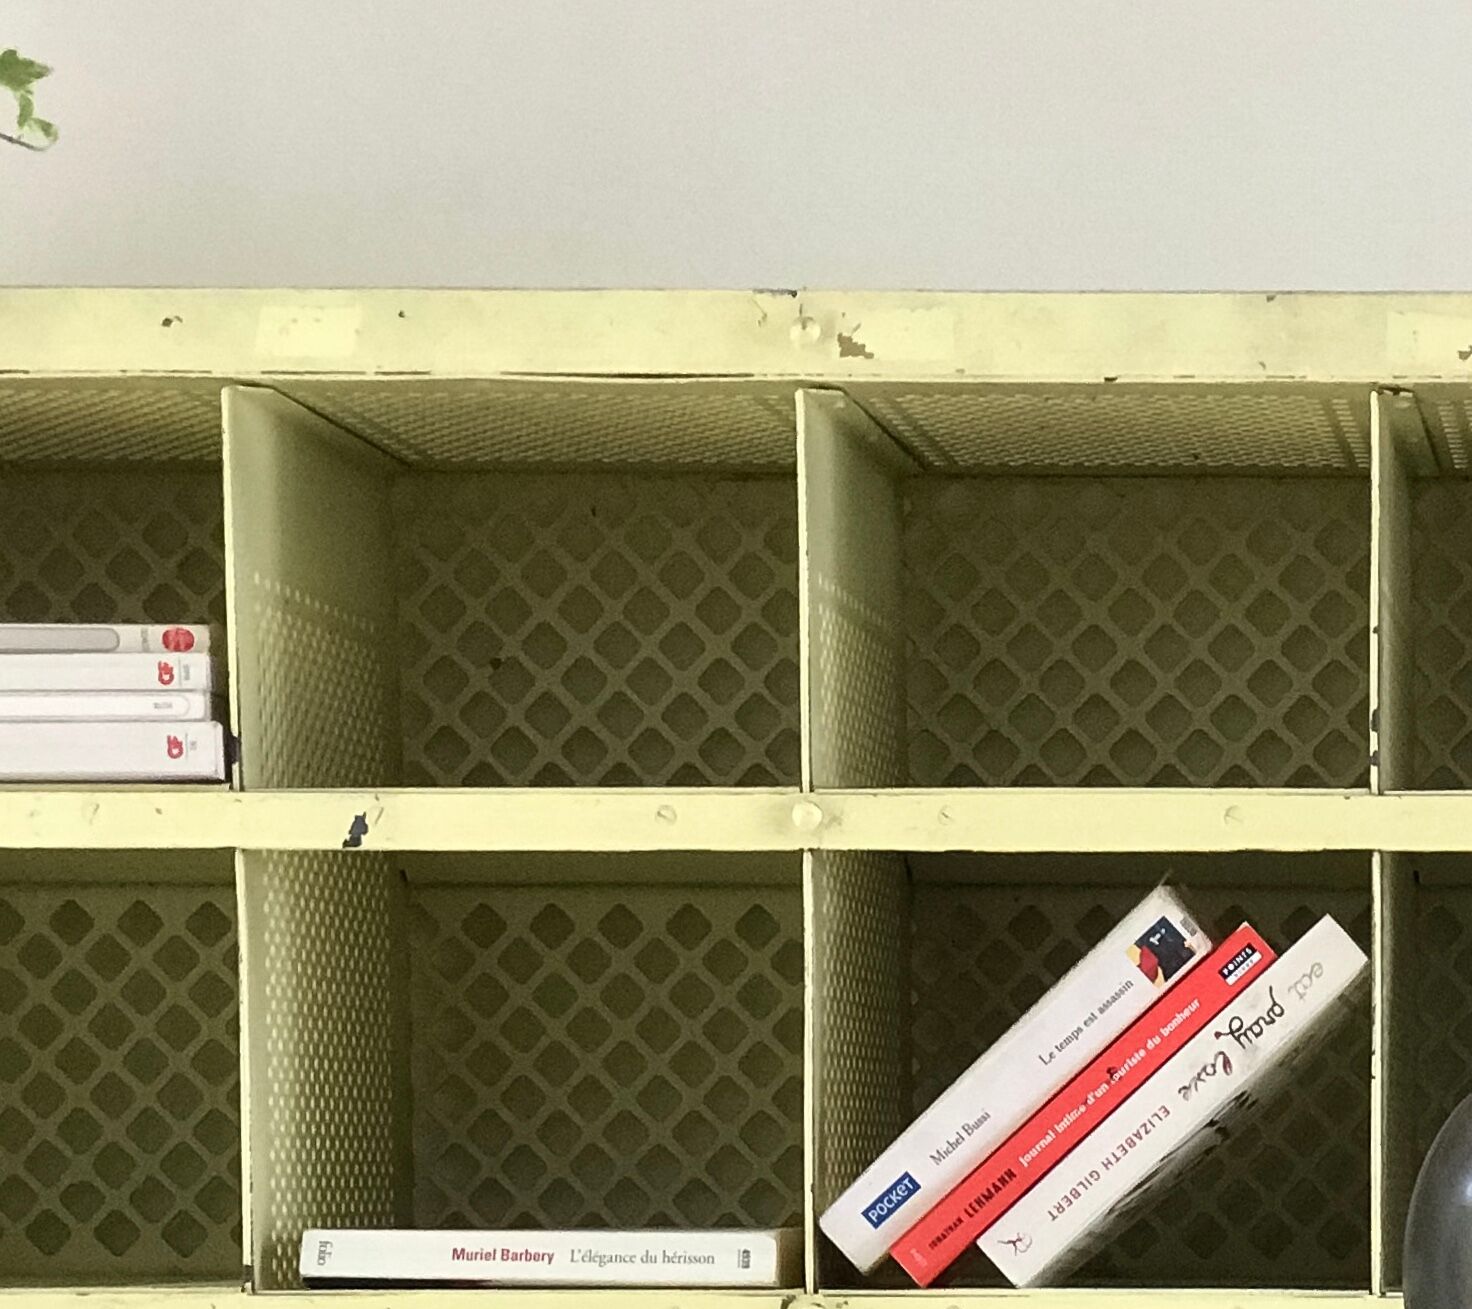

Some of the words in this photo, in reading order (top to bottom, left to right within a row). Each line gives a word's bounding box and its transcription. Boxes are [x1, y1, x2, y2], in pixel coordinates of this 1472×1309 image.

[1288, 962, 1324, 1000] eat
[1038, 1053, 1057, 1066] Le
[1054, 1025, 1084, 1052] temps
[1083, 1012, 1098, 1027] est
[1099, 979, 1135, 1015] assassin
[1214, 985, 1285, 1050] pray
[1018, 1129, 1055, 1168] Journal
[1086, 1083, 1110, 1106] d'un
[1145, 1036, 1161, 1050] du
[1159, 998, 1201, 1037] bonheur
[930, 1131, 965, 1166] Michel
[962, 1108, 991, 1137] Bussi
[1101, 1105, 1171, 1171] ELIZABETH
[868, 1177, 915, 1223] POCKET
[964, 1168, 1017, 1218] LEHMANN
[1047, 1169, 1101, 1222] GILBERT
[317, 1239, 333, 1266] folio
[451, 1247, 496, 1263] Muriel
[500, 1248, 555, 1265] Barbery
[570, 1247, 637, 1266] L'élégance
[640, 1248, 658, 1264] du
[662, 1248, 715, 1266] hérisson
